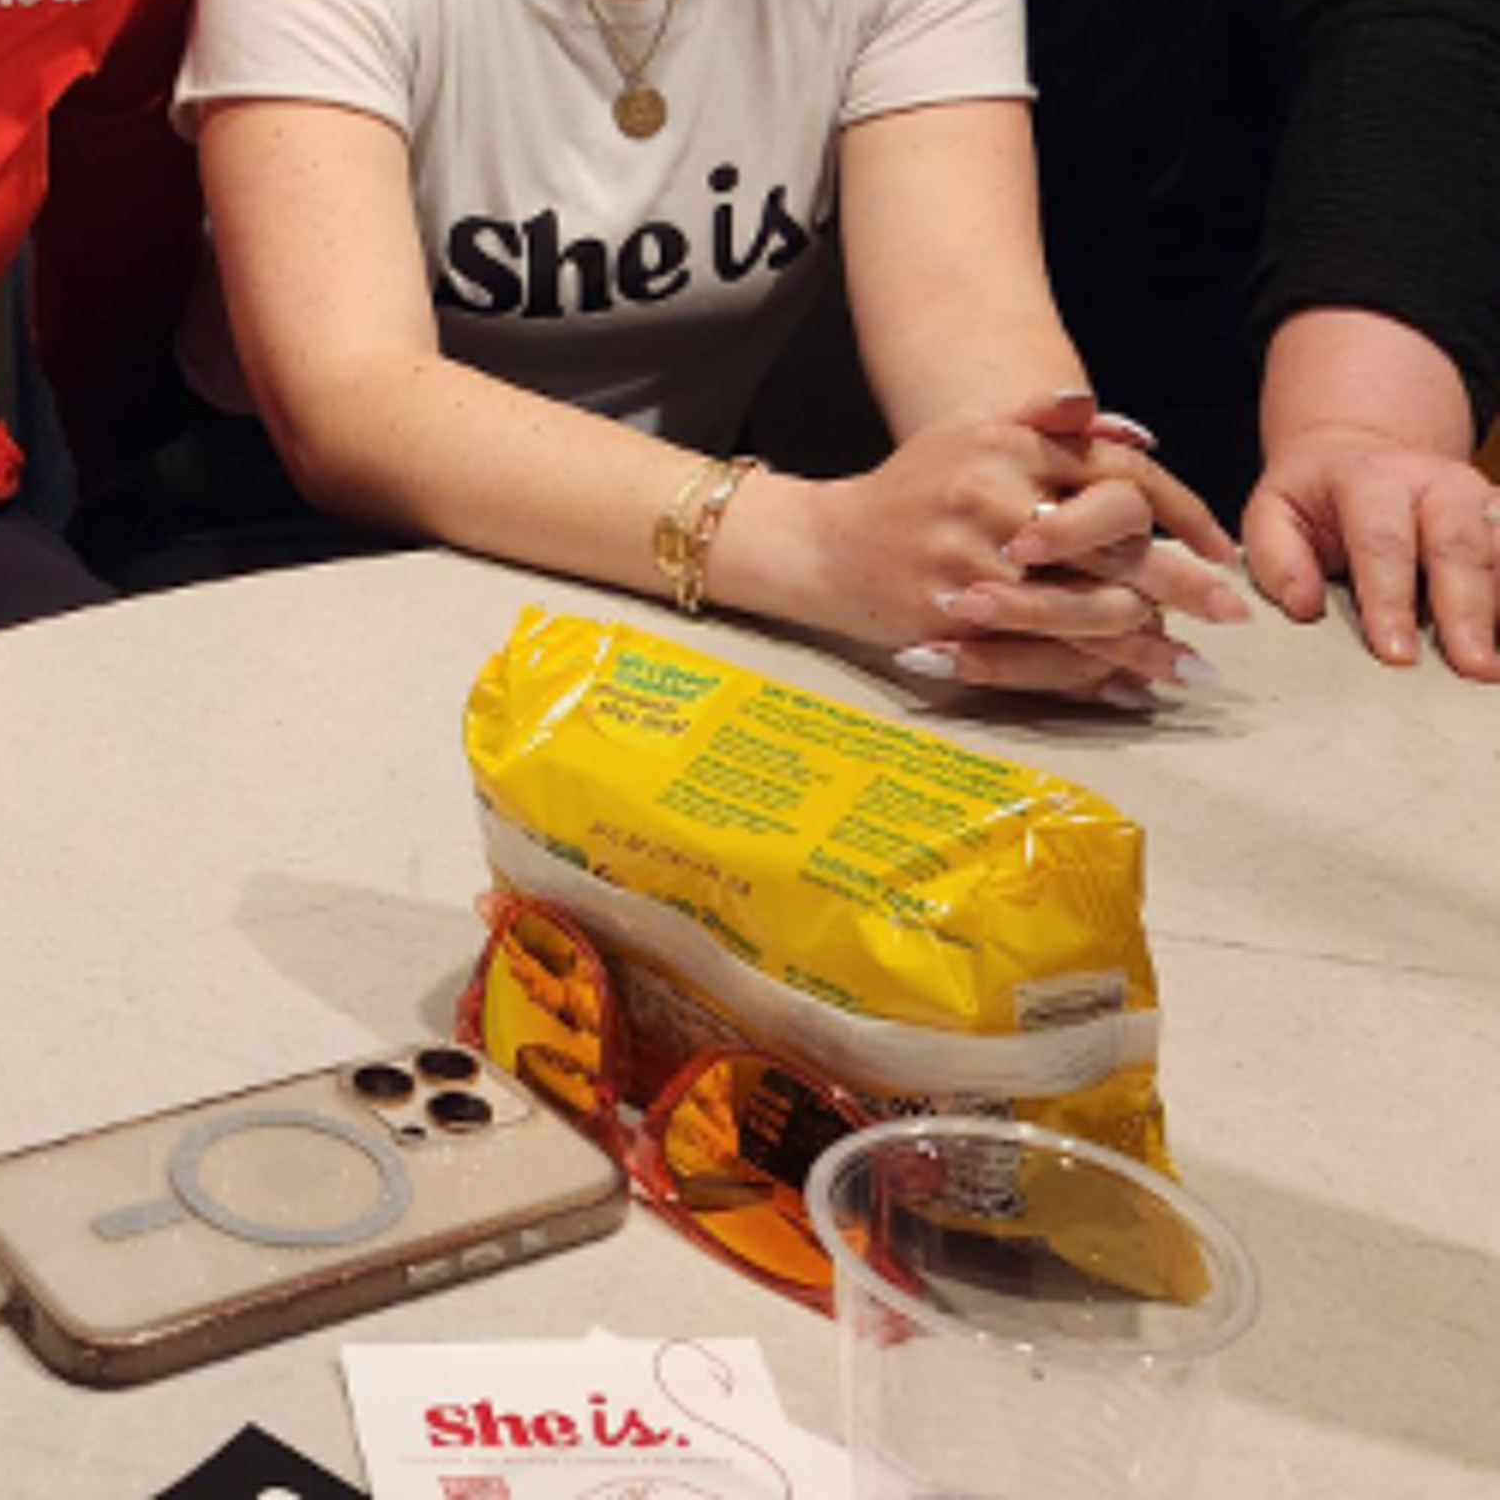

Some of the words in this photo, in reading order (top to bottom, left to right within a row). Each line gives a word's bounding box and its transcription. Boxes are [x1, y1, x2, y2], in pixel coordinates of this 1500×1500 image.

[432, 208, 691, 320] She
[424, 1397, 581, 1448] She
[588, 1392, 692, 1448] is.
